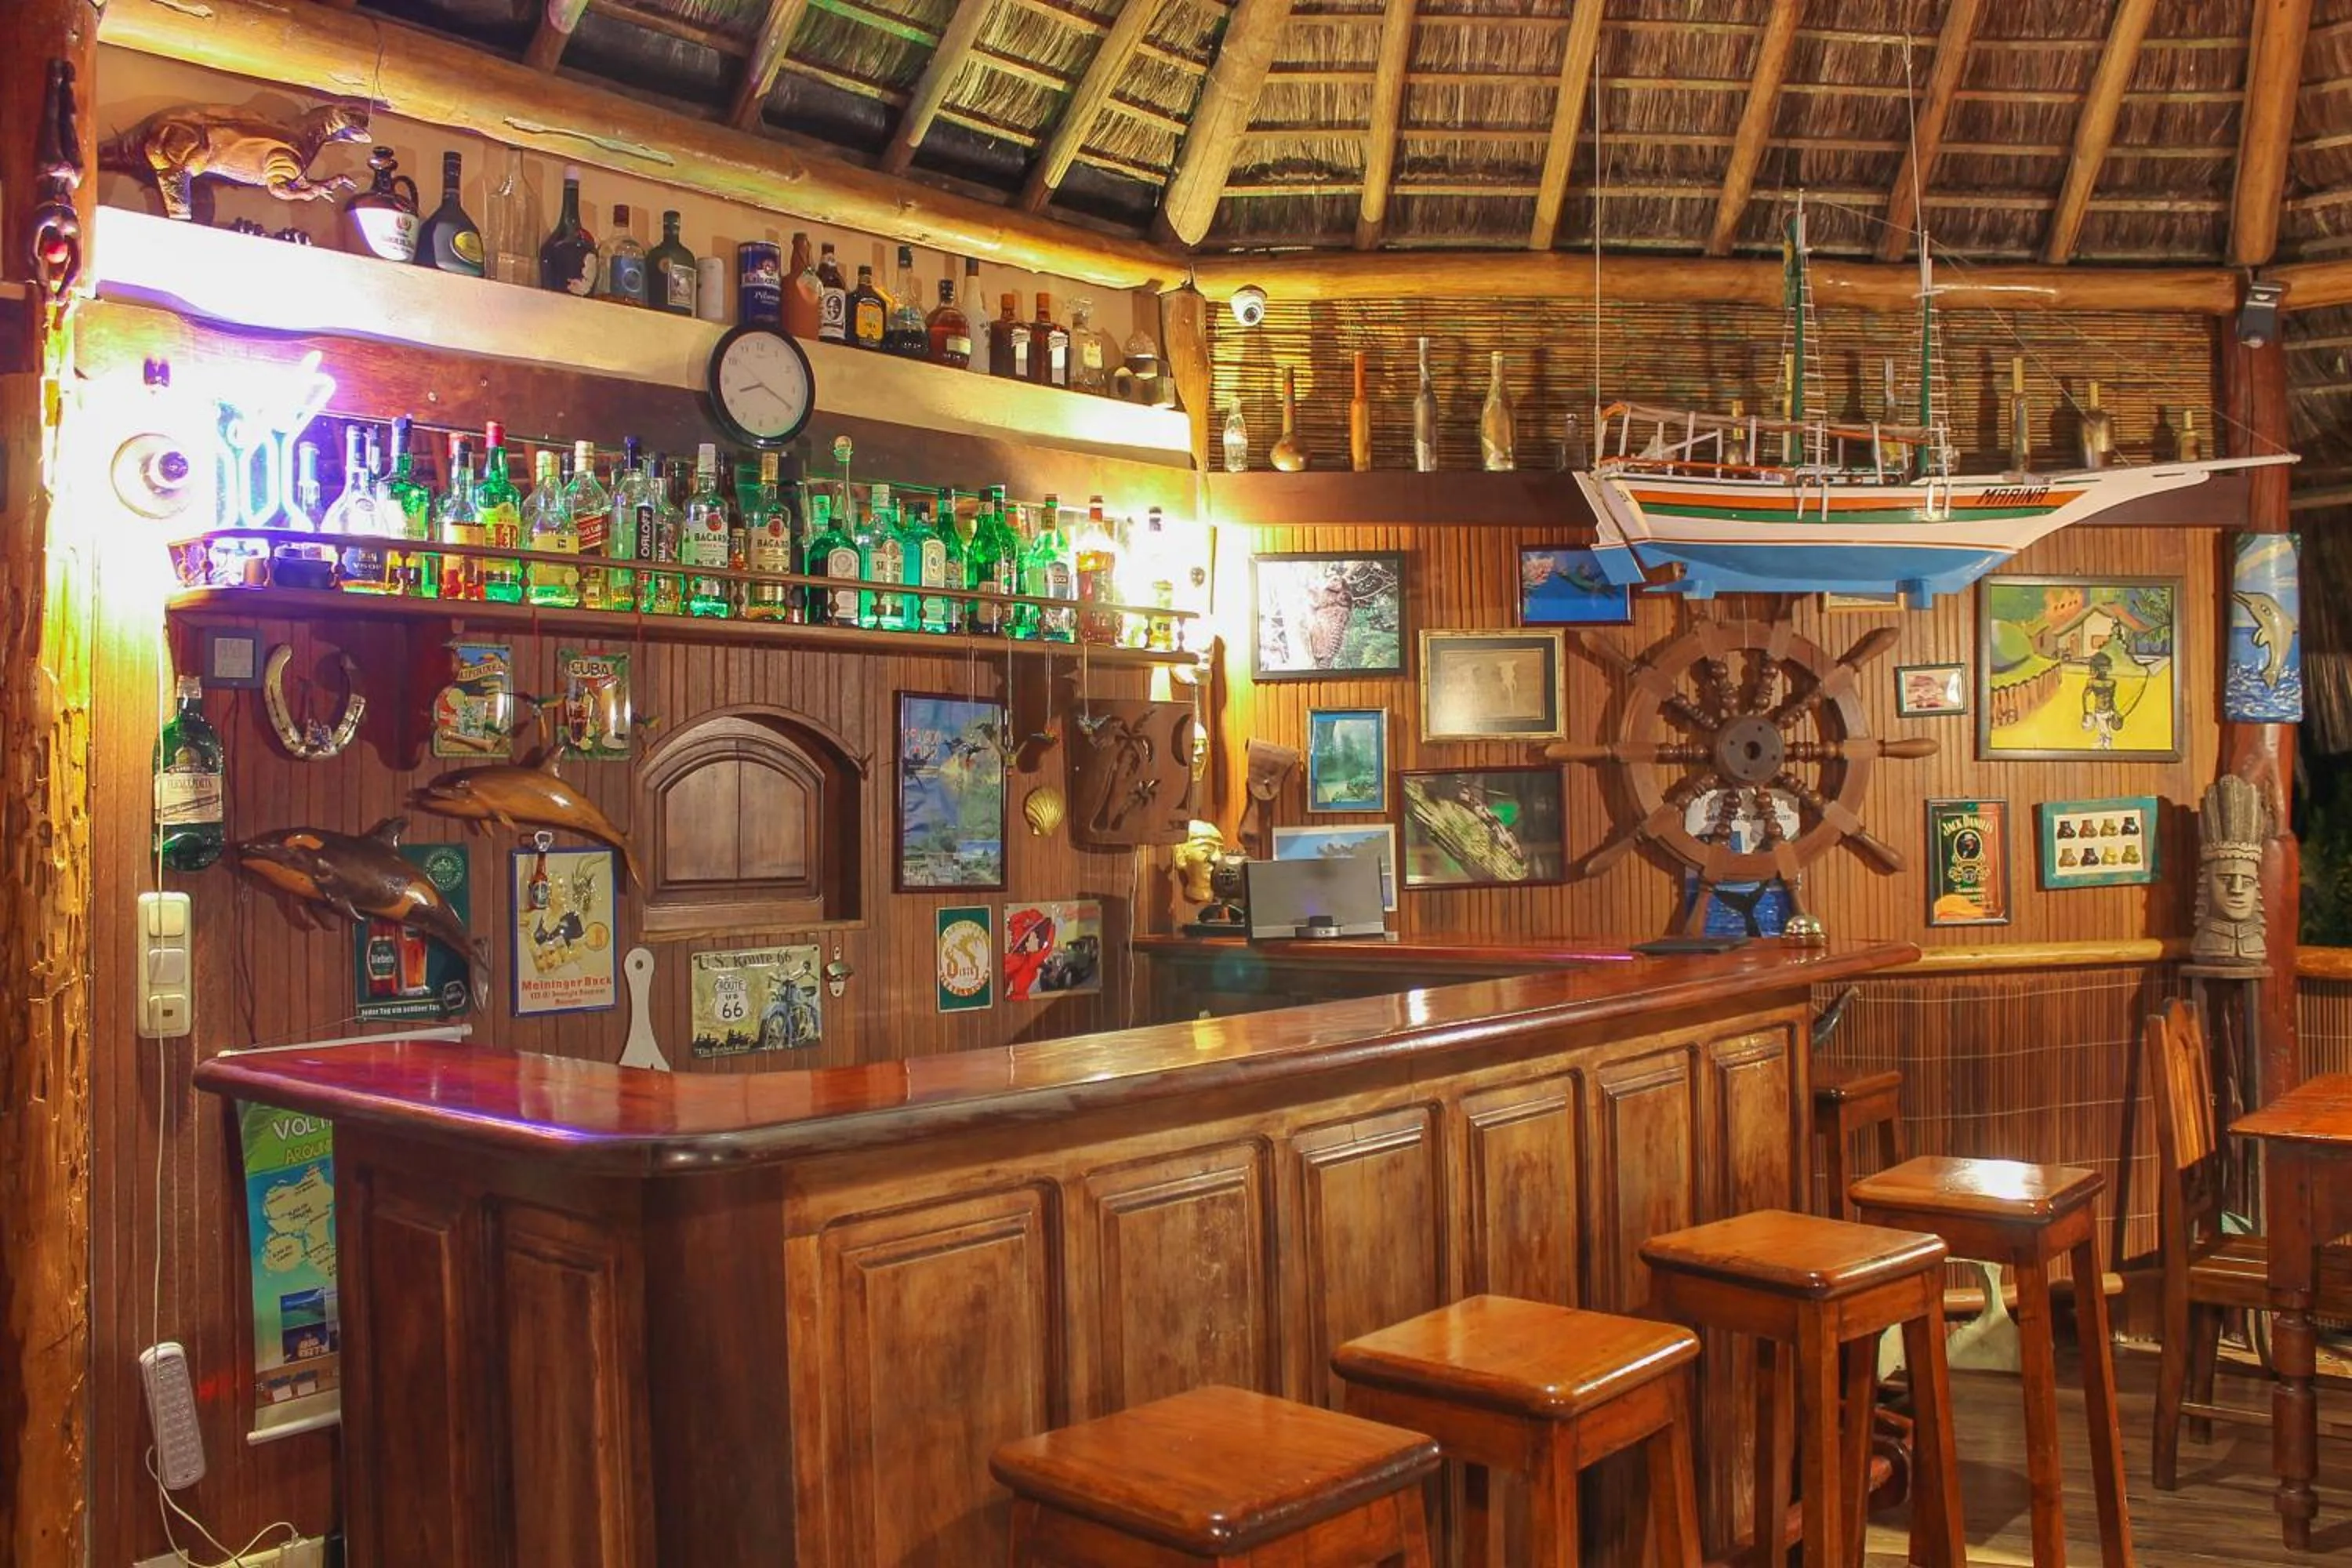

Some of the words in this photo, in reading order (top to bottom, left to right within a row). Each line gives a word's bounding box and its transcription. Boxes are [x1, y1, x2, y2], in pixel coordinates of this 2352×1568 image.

[1976, 487, 2050, 504] MARINA
[757, 539, 790, 548] BACARD
[572, 661, 609, 675] CUBA
[777, 949, 792, 964] 66
[722, 1001, 743, 1019] 66
